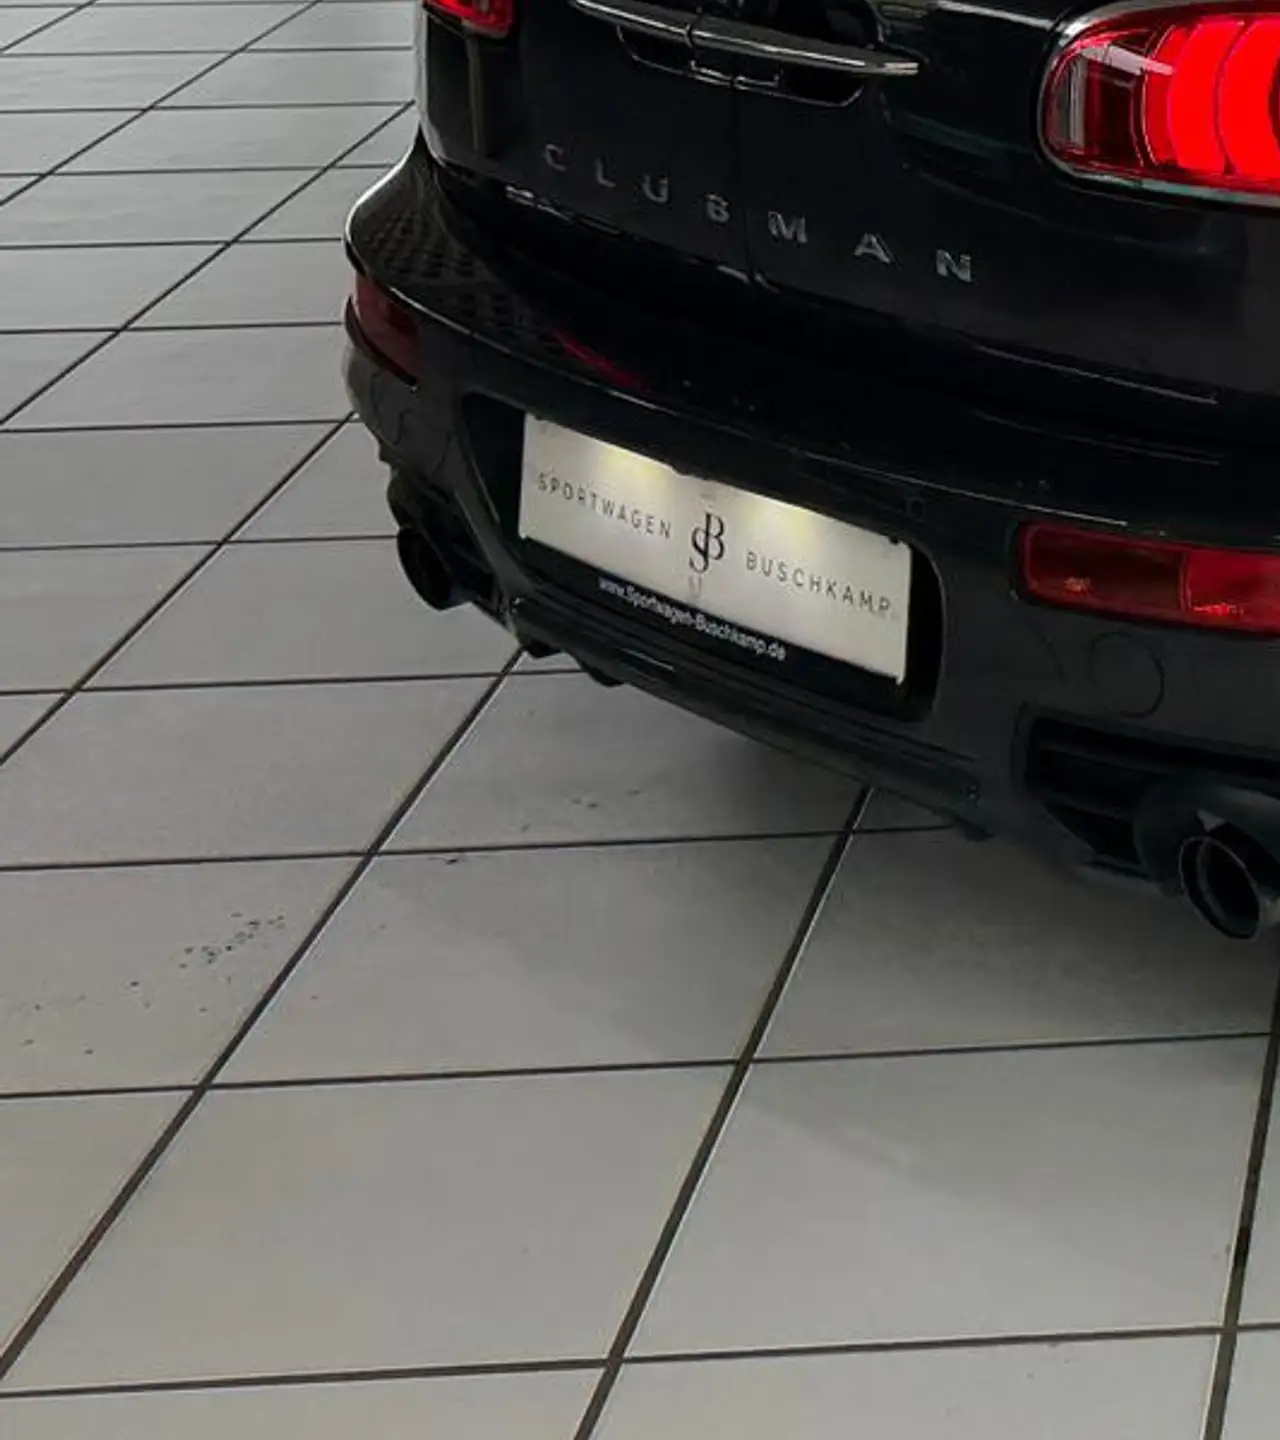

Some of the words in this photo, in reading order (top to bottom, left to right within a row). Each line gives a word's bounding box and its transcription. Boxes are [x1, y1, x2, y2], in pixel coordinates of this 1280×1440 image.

[543, 143, 973, 283] CLUBMAN
[536, 471, 672, 540] SPORTWAGEN
[745, 550, 892, 613] BUSCHKAMP
